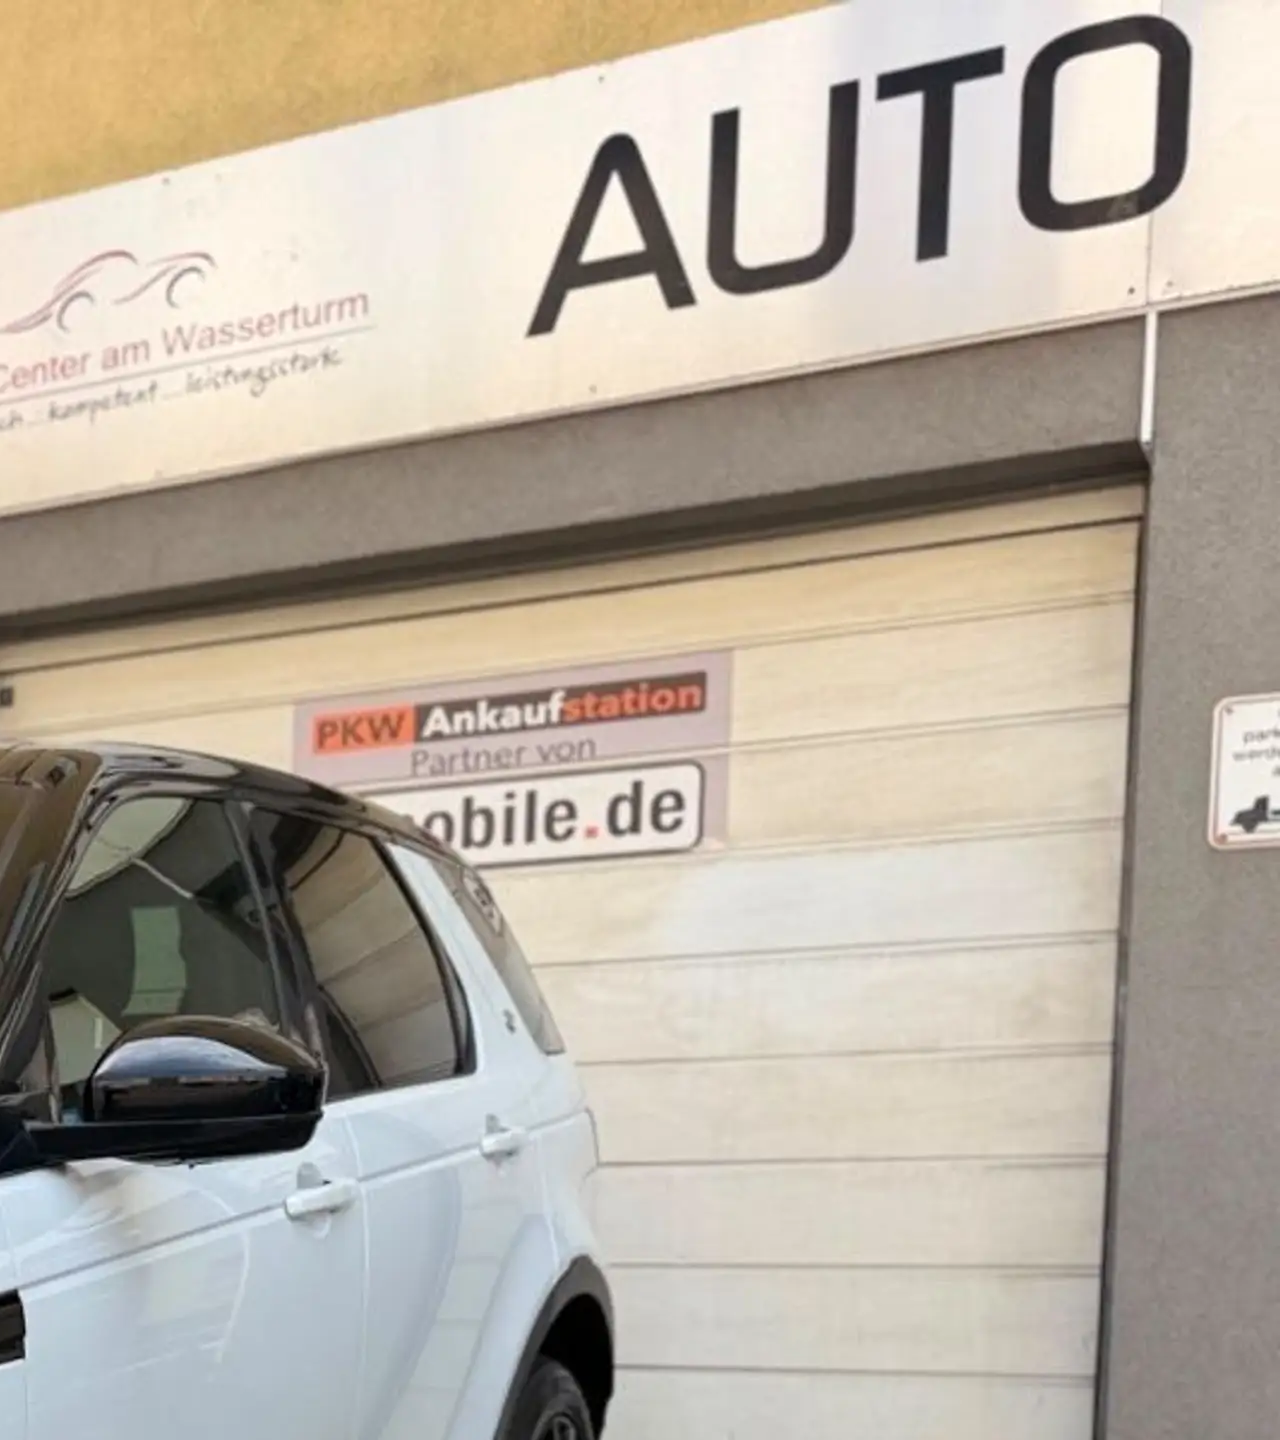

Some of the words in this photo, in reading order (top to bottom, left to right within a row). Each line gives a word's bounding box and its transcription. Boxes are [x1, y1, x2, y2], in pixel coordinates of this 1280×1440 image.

[527, 14, 1191, 337] AUTO
[101, 338, 151, 371] am
[161, 292, 370, 357] Wasserturm
[316, 710, 407, 750] PKW
[421, 682, 705, 740] Ankaufstation
[410, 746, 528, 778] Partner
[536, 736, 597, 763] von
[422, 778, 688, 851] obile.de
